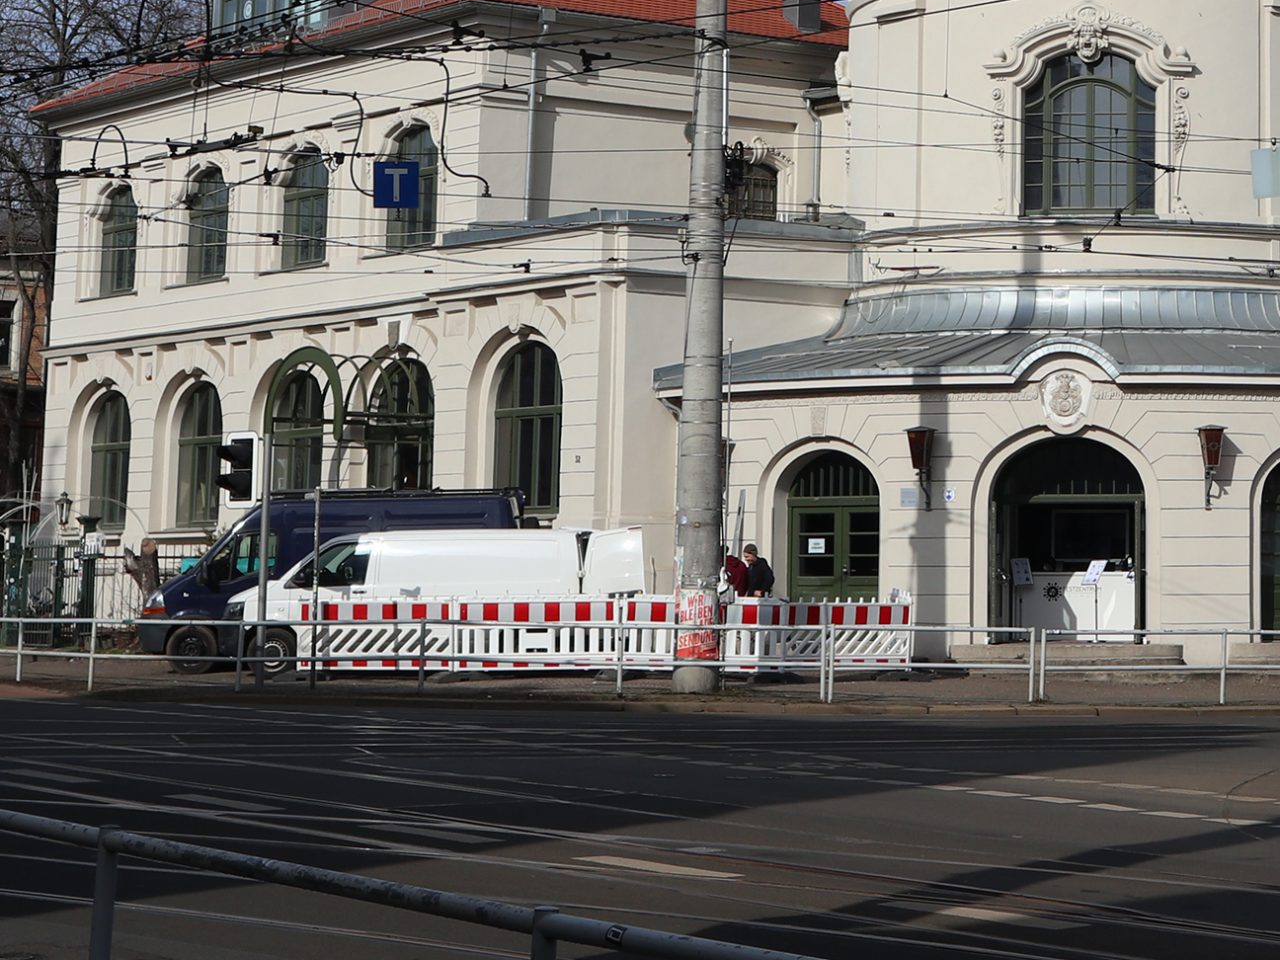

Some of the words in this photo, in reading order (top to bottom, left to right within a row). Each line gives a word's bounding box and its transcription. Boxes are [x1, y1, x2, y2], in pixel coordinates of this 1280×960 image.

[384, 168, 408, 202] T
[688, 594, 704, 608] WR
[680, 605, 713, 622] BLEBEN
